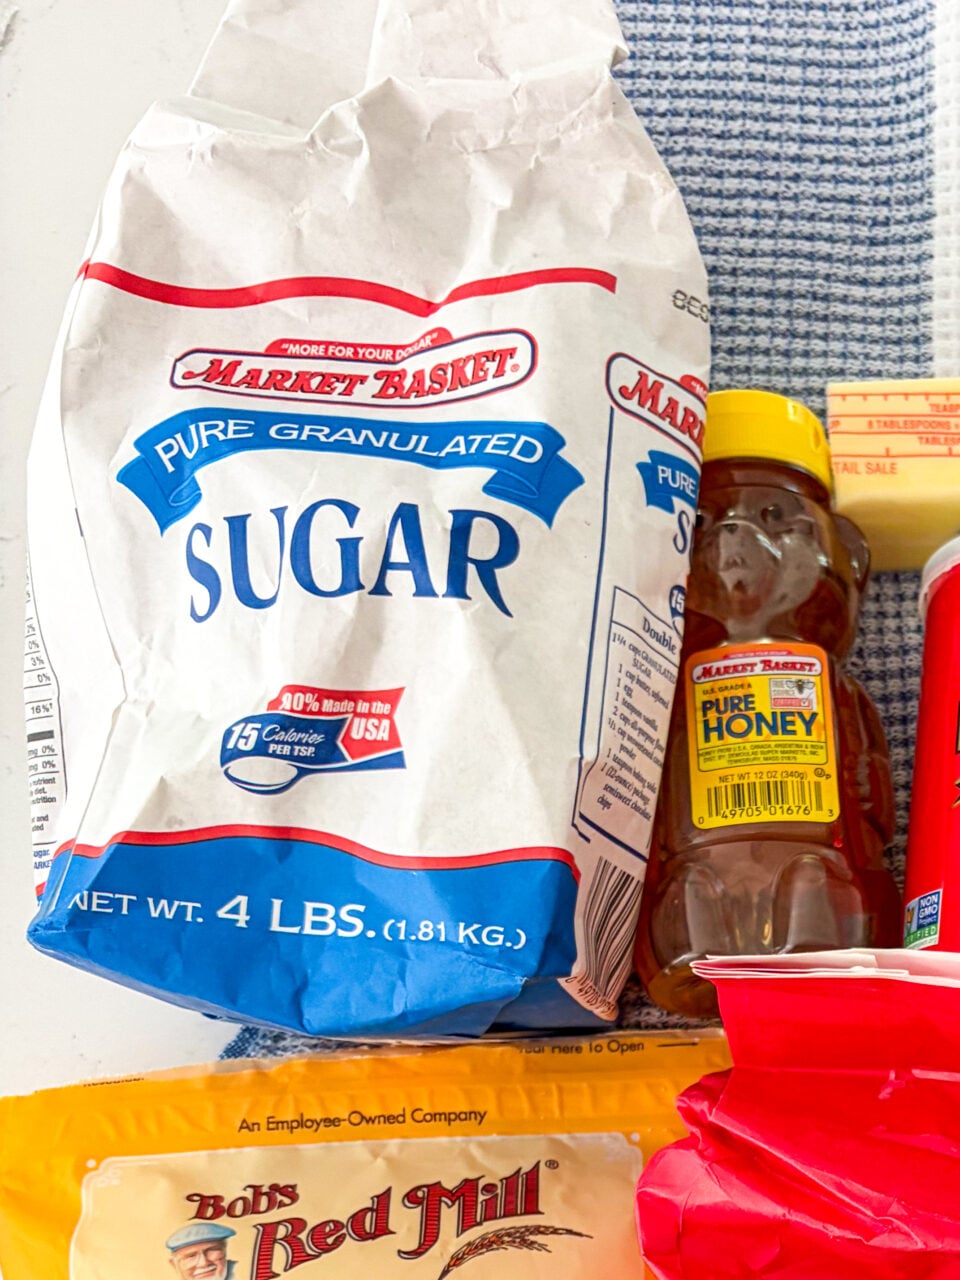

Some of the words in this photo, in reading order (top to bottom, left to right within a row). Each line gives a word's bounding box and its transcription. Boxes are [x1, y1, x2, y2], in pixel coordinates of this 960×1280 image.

[182, 358, 368, 398] MARKET
[371, 347, 518, 399] BASKET
[153, 420, 254, 473] PURE
[268, 424, 542, 463] GRANULATED
[866, 462, 898, 474] SALE
[180, 499, 521, 623] SUGAR
[696, 663, 757, 681] MARKET
[760, 659, 816, 673] BASKET
[322, 700, 354, 712] Made
[357, 700, 369, 713] in
[371, 700, 391, 714] the
[702, 694, 756, 717] PURE
[226, 723, 261, 750] 15
[262, 724, 325, 743] Calories
[352, 718, 389, 740] USA
[703, 711, 818, 743] HONEY
[721, 807, 762, 820] 49705
[769, 806, 811, 815] 01676
[68, 891, 137, 913] NET
[148, 898, 204, 924] WT.
[217, 895, 250, 928] 4
[269, 899, 376, 939] LBS.
[384, 921, 446, 943] (1.81
[458, 922, 526, 950] KG.)
[238, 1117, 261, 1133] An
[266, 1110, 406, 1133] Employee-Owned
[411, 1107, 488, 1127] Company
[185, 1183, 299, 1221] Bob's
[397, 1159, 544, 1260] Mill
